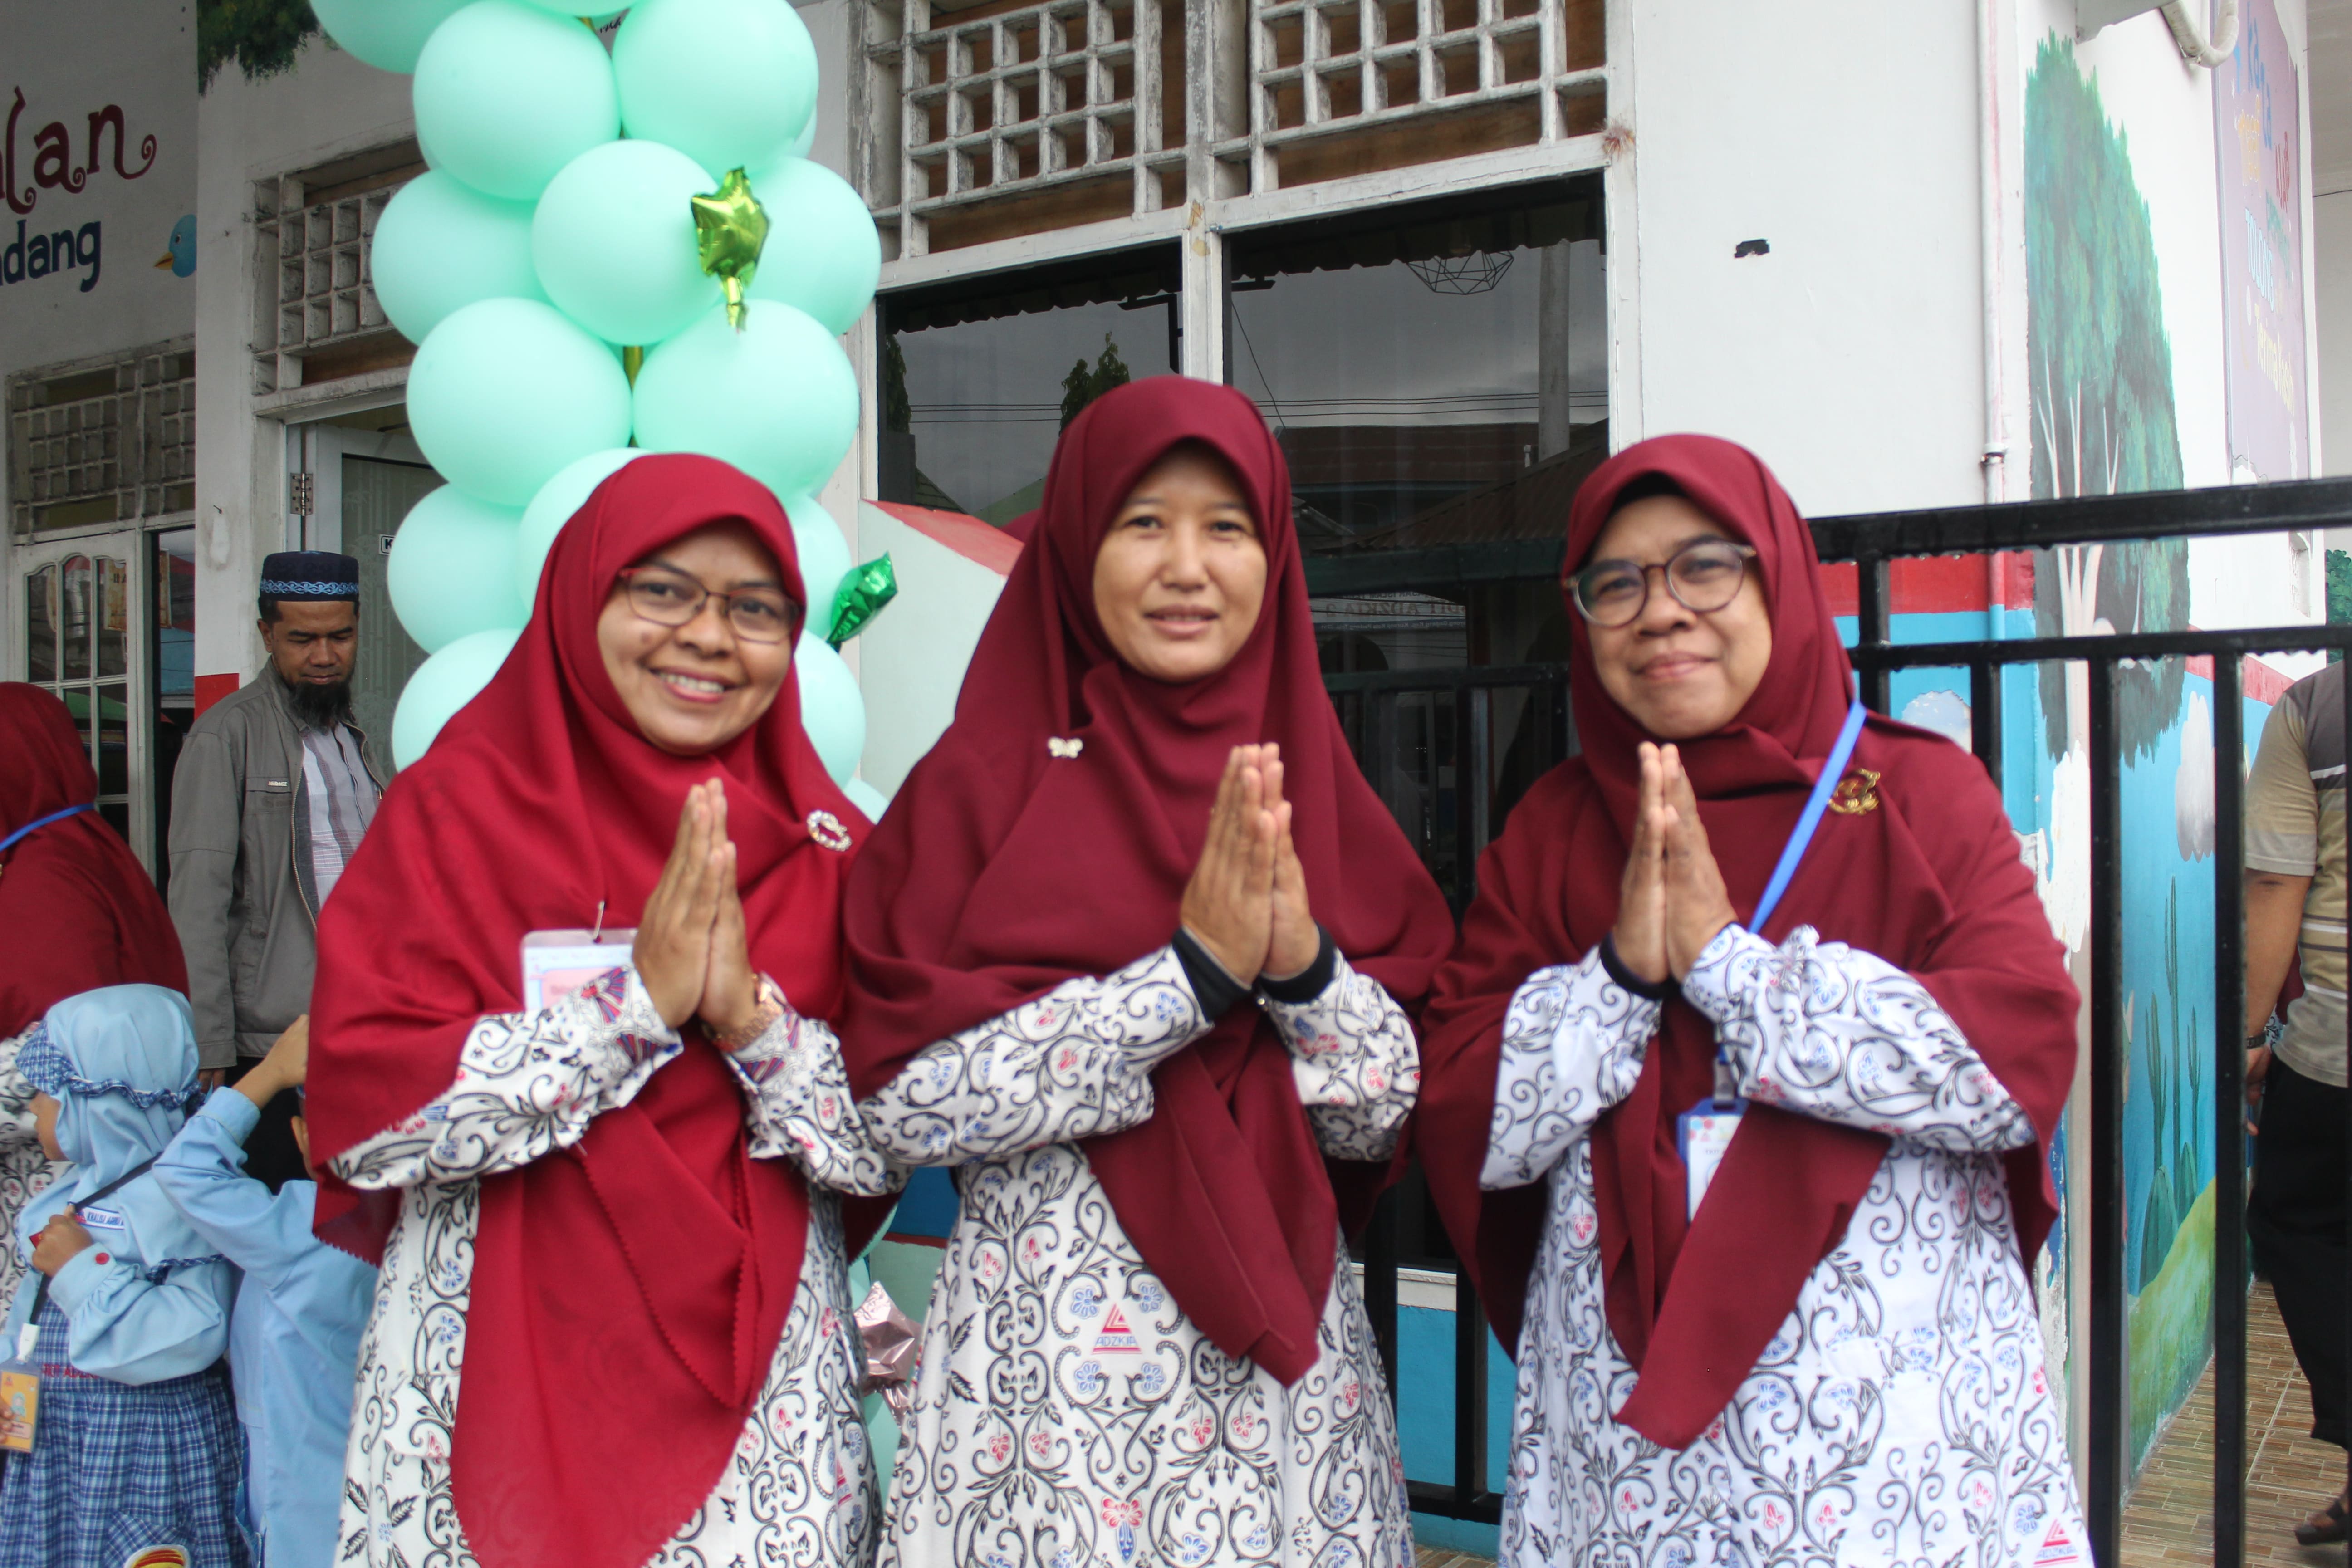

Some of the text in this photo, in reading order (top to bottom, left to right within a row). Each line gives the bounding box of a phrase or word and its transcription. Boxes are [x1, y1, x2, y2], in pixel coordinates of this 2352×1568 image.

[0, 85, 157, 215] lan
[0, 219, 102, 293] dang
[2245, 206, 2274, 313] TOLONG
[1094, 1336, 1139, 1347] ADZKIA
